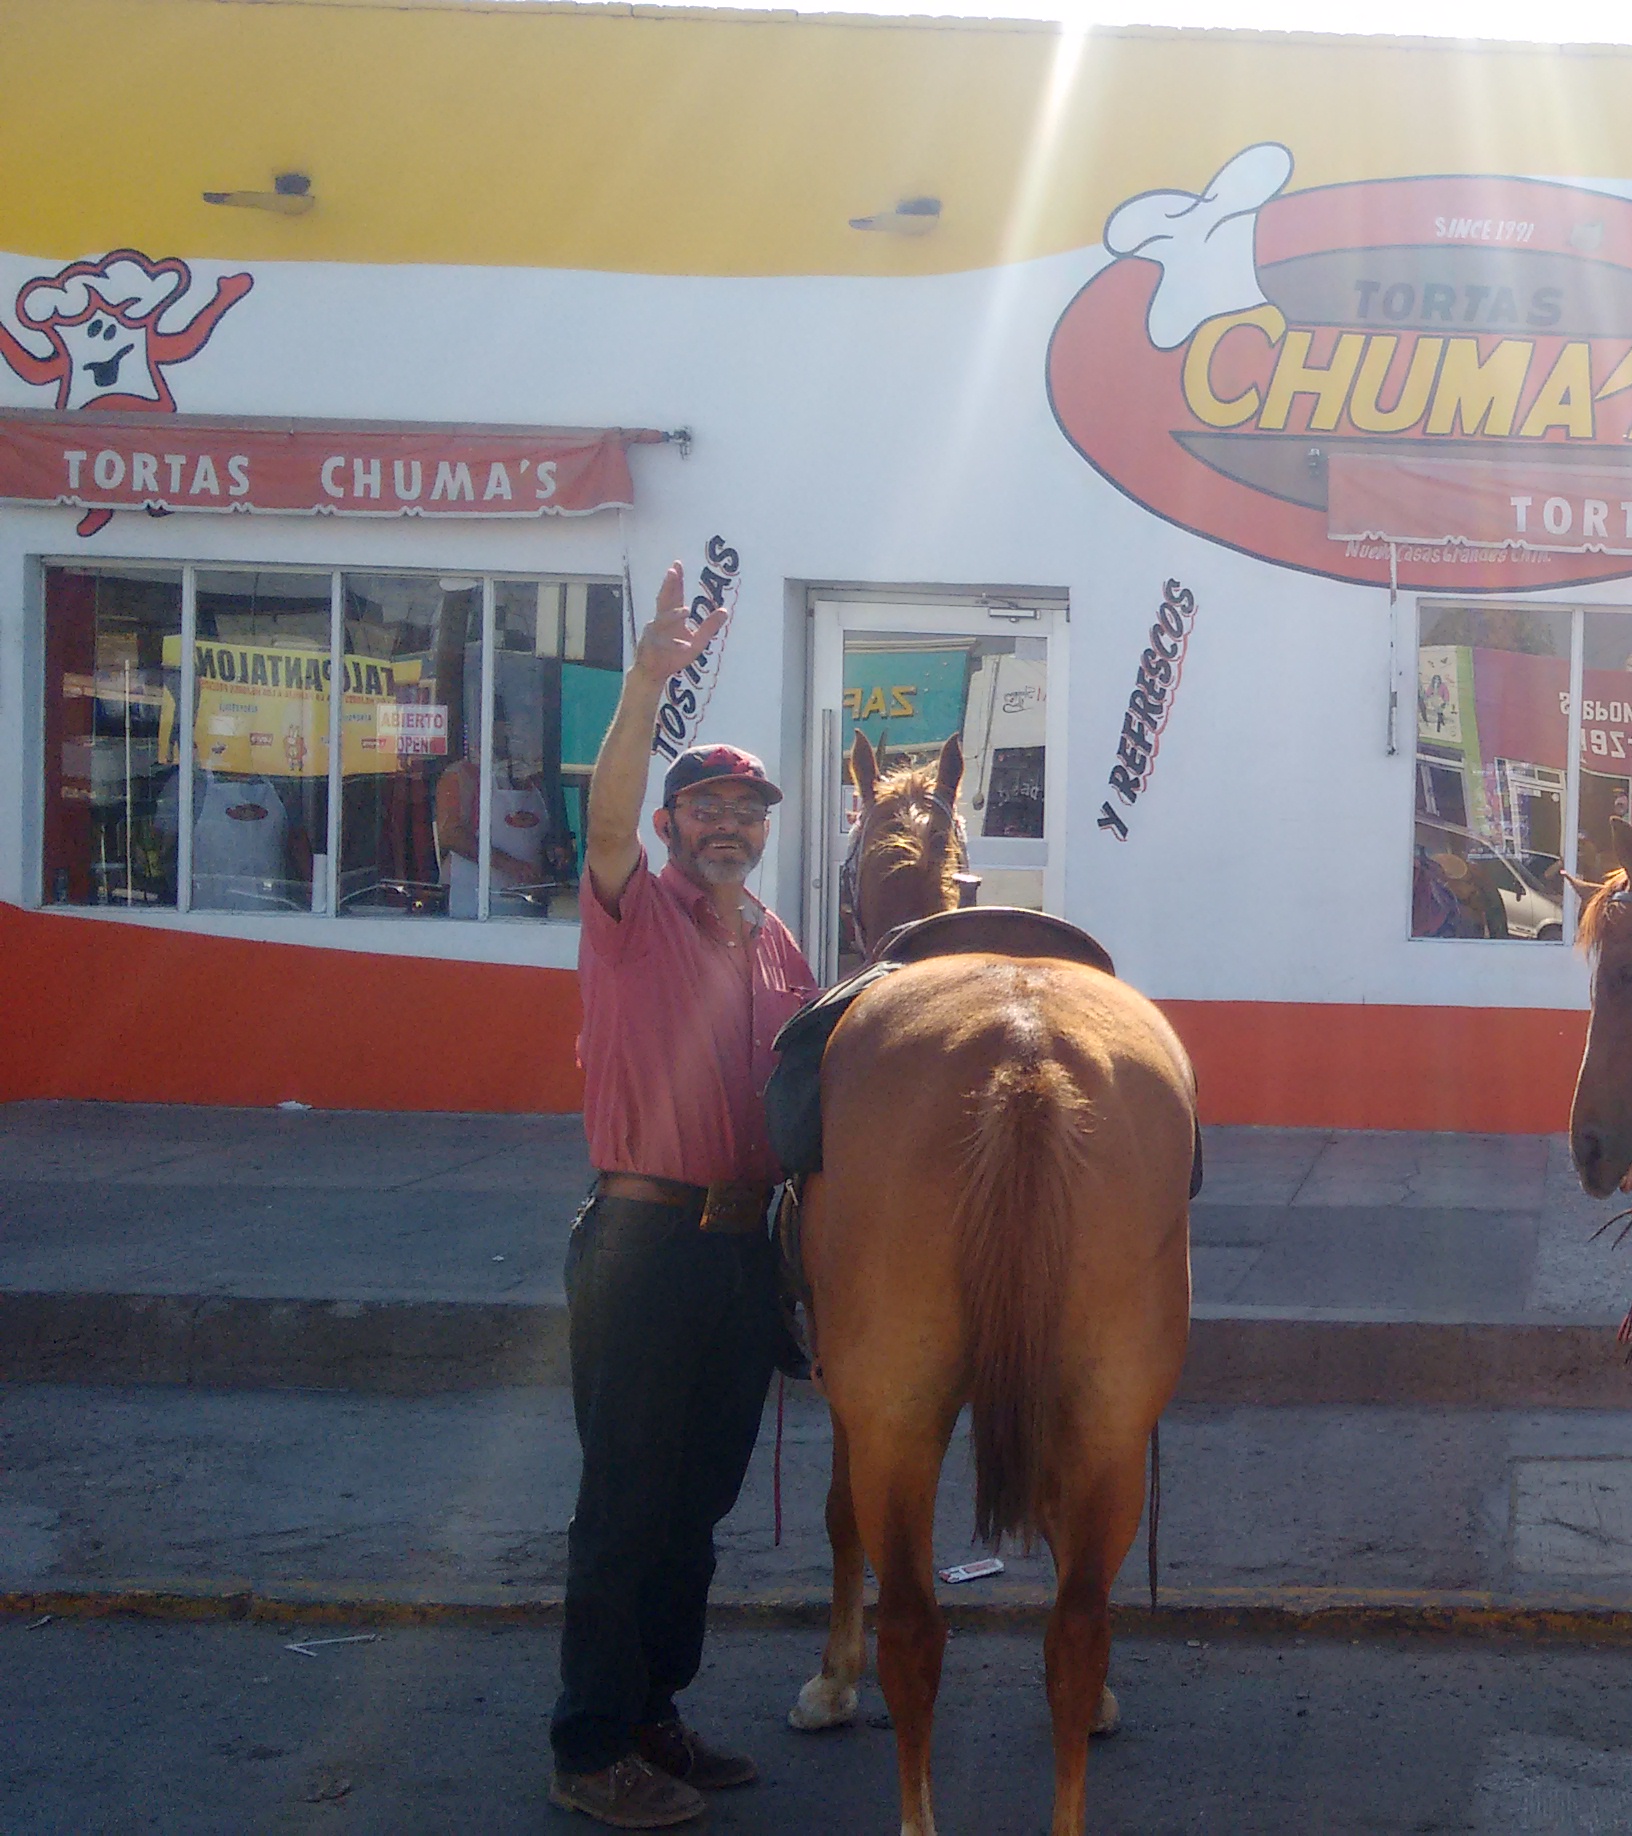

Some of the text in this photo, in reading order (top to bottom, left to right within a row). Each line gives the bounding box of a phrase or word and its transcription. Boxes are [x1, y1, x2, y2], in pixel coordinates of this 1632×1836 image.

[1435, 216, 1535, 243] SINCE 1991
[1354, 280, 1564, 326] TORTAS
[63, 450, 558, 501] TORTAS CHUMA'S
[651, 534, 740, 763] TOSDAS
[381, 712, 443, 729] ABIERTO
[1096, 578, 1198, 842] Y REFRESCOS
[398, 736, 428, 752] OPEN
